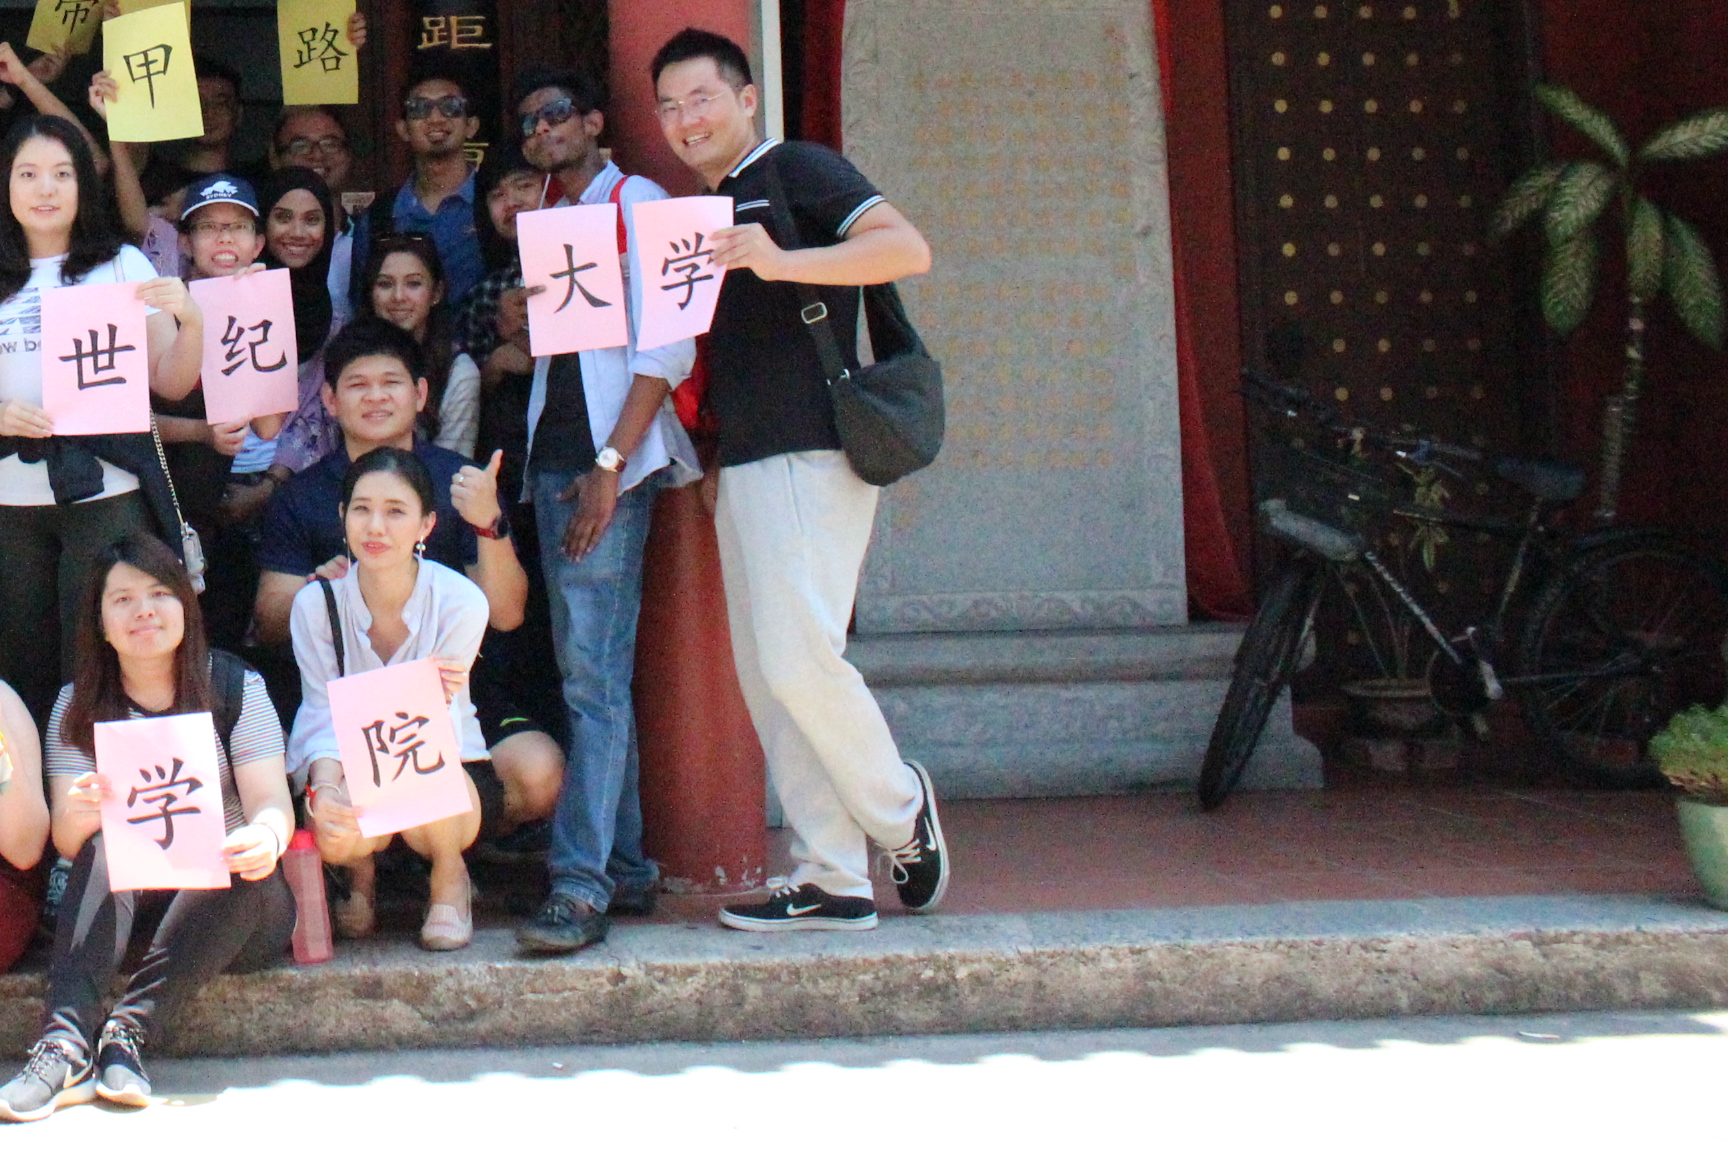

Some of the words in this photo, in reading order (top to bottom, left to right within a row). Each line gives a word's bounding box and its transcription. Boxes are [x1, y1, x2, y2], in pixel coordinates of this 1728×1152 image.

[123, 43, 174, 109] 甲
[292, 21, 349, 74] 路
[548, 243, 613, 315] 大
[660, 231, 714, 311] 学
[57, 322, 137, 392] 世
[219, 314, 290, 378] 纪
[359, 710, 448, 788] 院
[125, 757, 204, 850] 学
